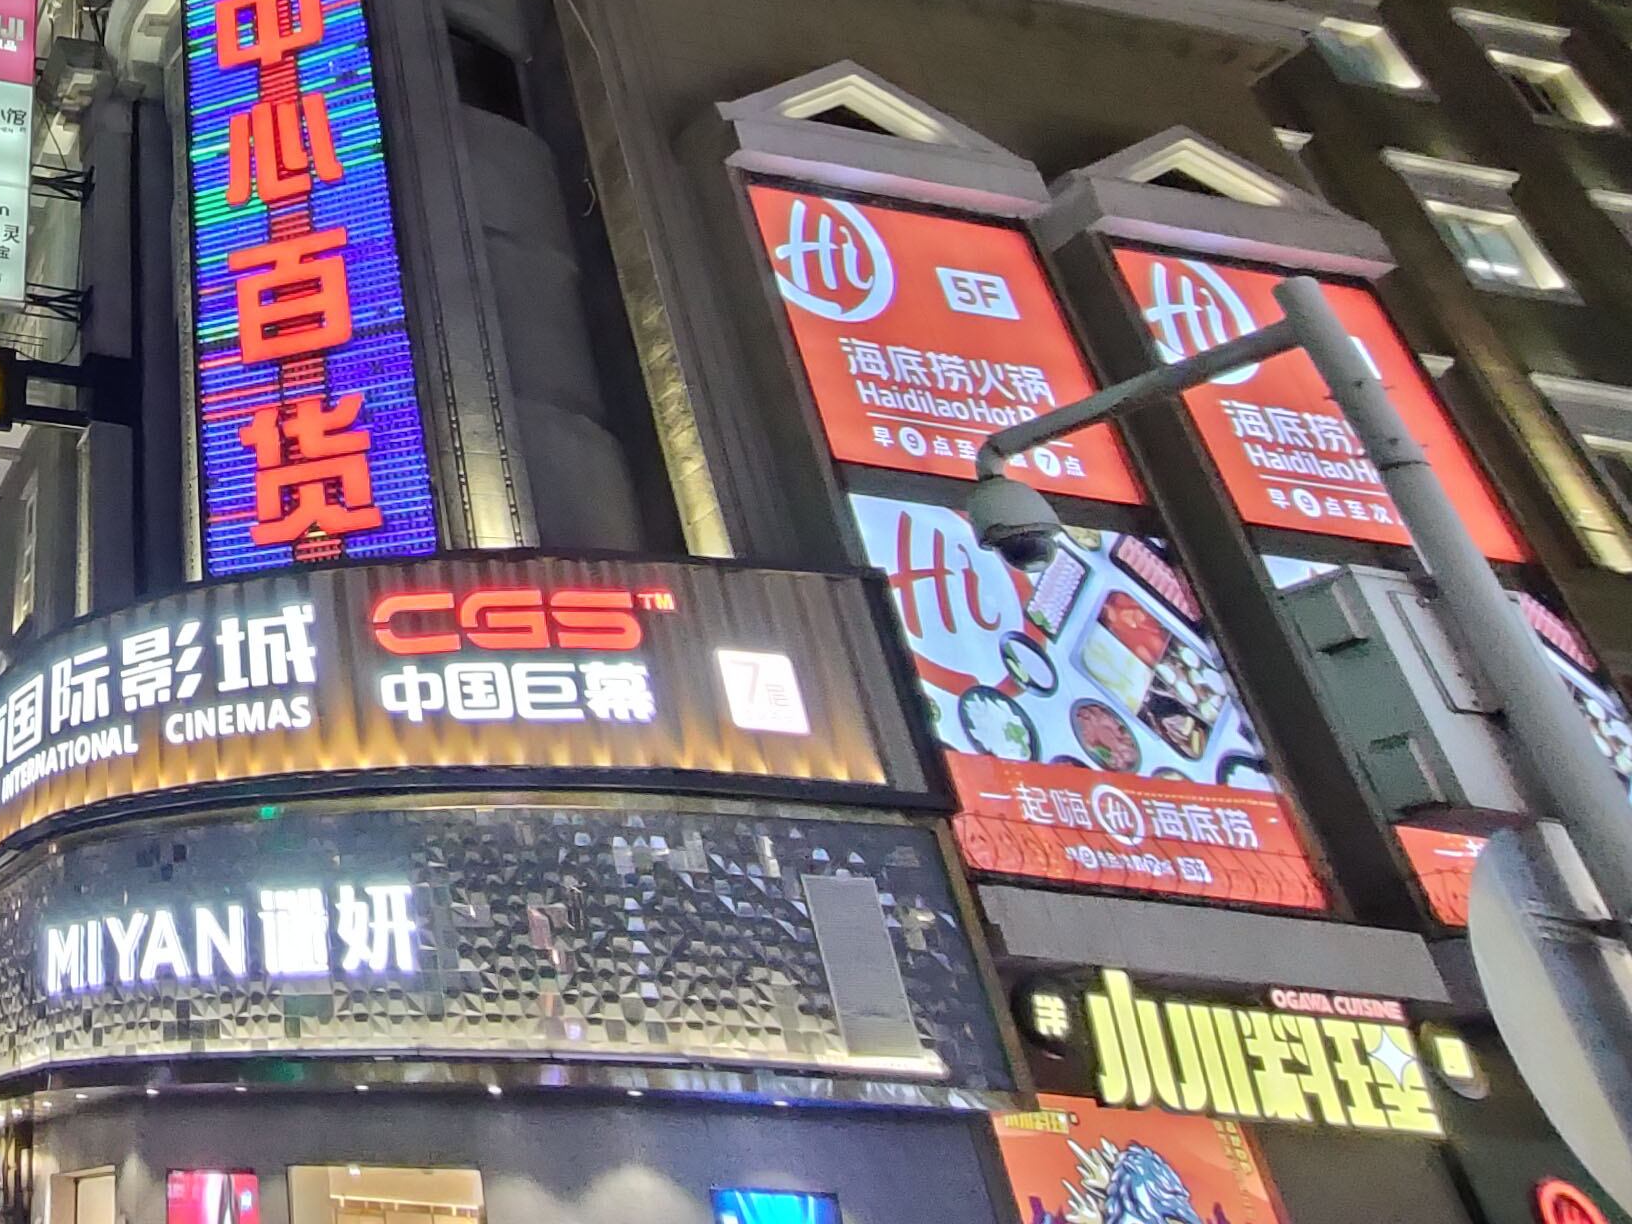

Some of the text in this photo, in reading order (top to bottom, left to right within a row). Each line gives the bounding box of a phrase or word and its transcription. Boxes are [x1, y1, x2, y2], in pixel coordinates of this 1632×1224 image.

[775, 199, 874, 293] Hi
[952, 276, 1001, 309] 5F
[838, 336, 1057, 409] 海底捞火锅
[888, 510, 1002, 640] Hi
[372, 589, 642, 655] CGS
[380, 662, 657, 723] 中国巨幕
[1, 724, 139, 803] INTERNATIONAL
[165, 696, 312, 744] CINEMAS
[1141, 798, 1259, 849] 海底捞
[47, 904, 248, 995] MIYAN
[1271, 988, 1406, 1022] OGAWA CUISINE
[1087, 969, 1446, 1137] 小川料理
